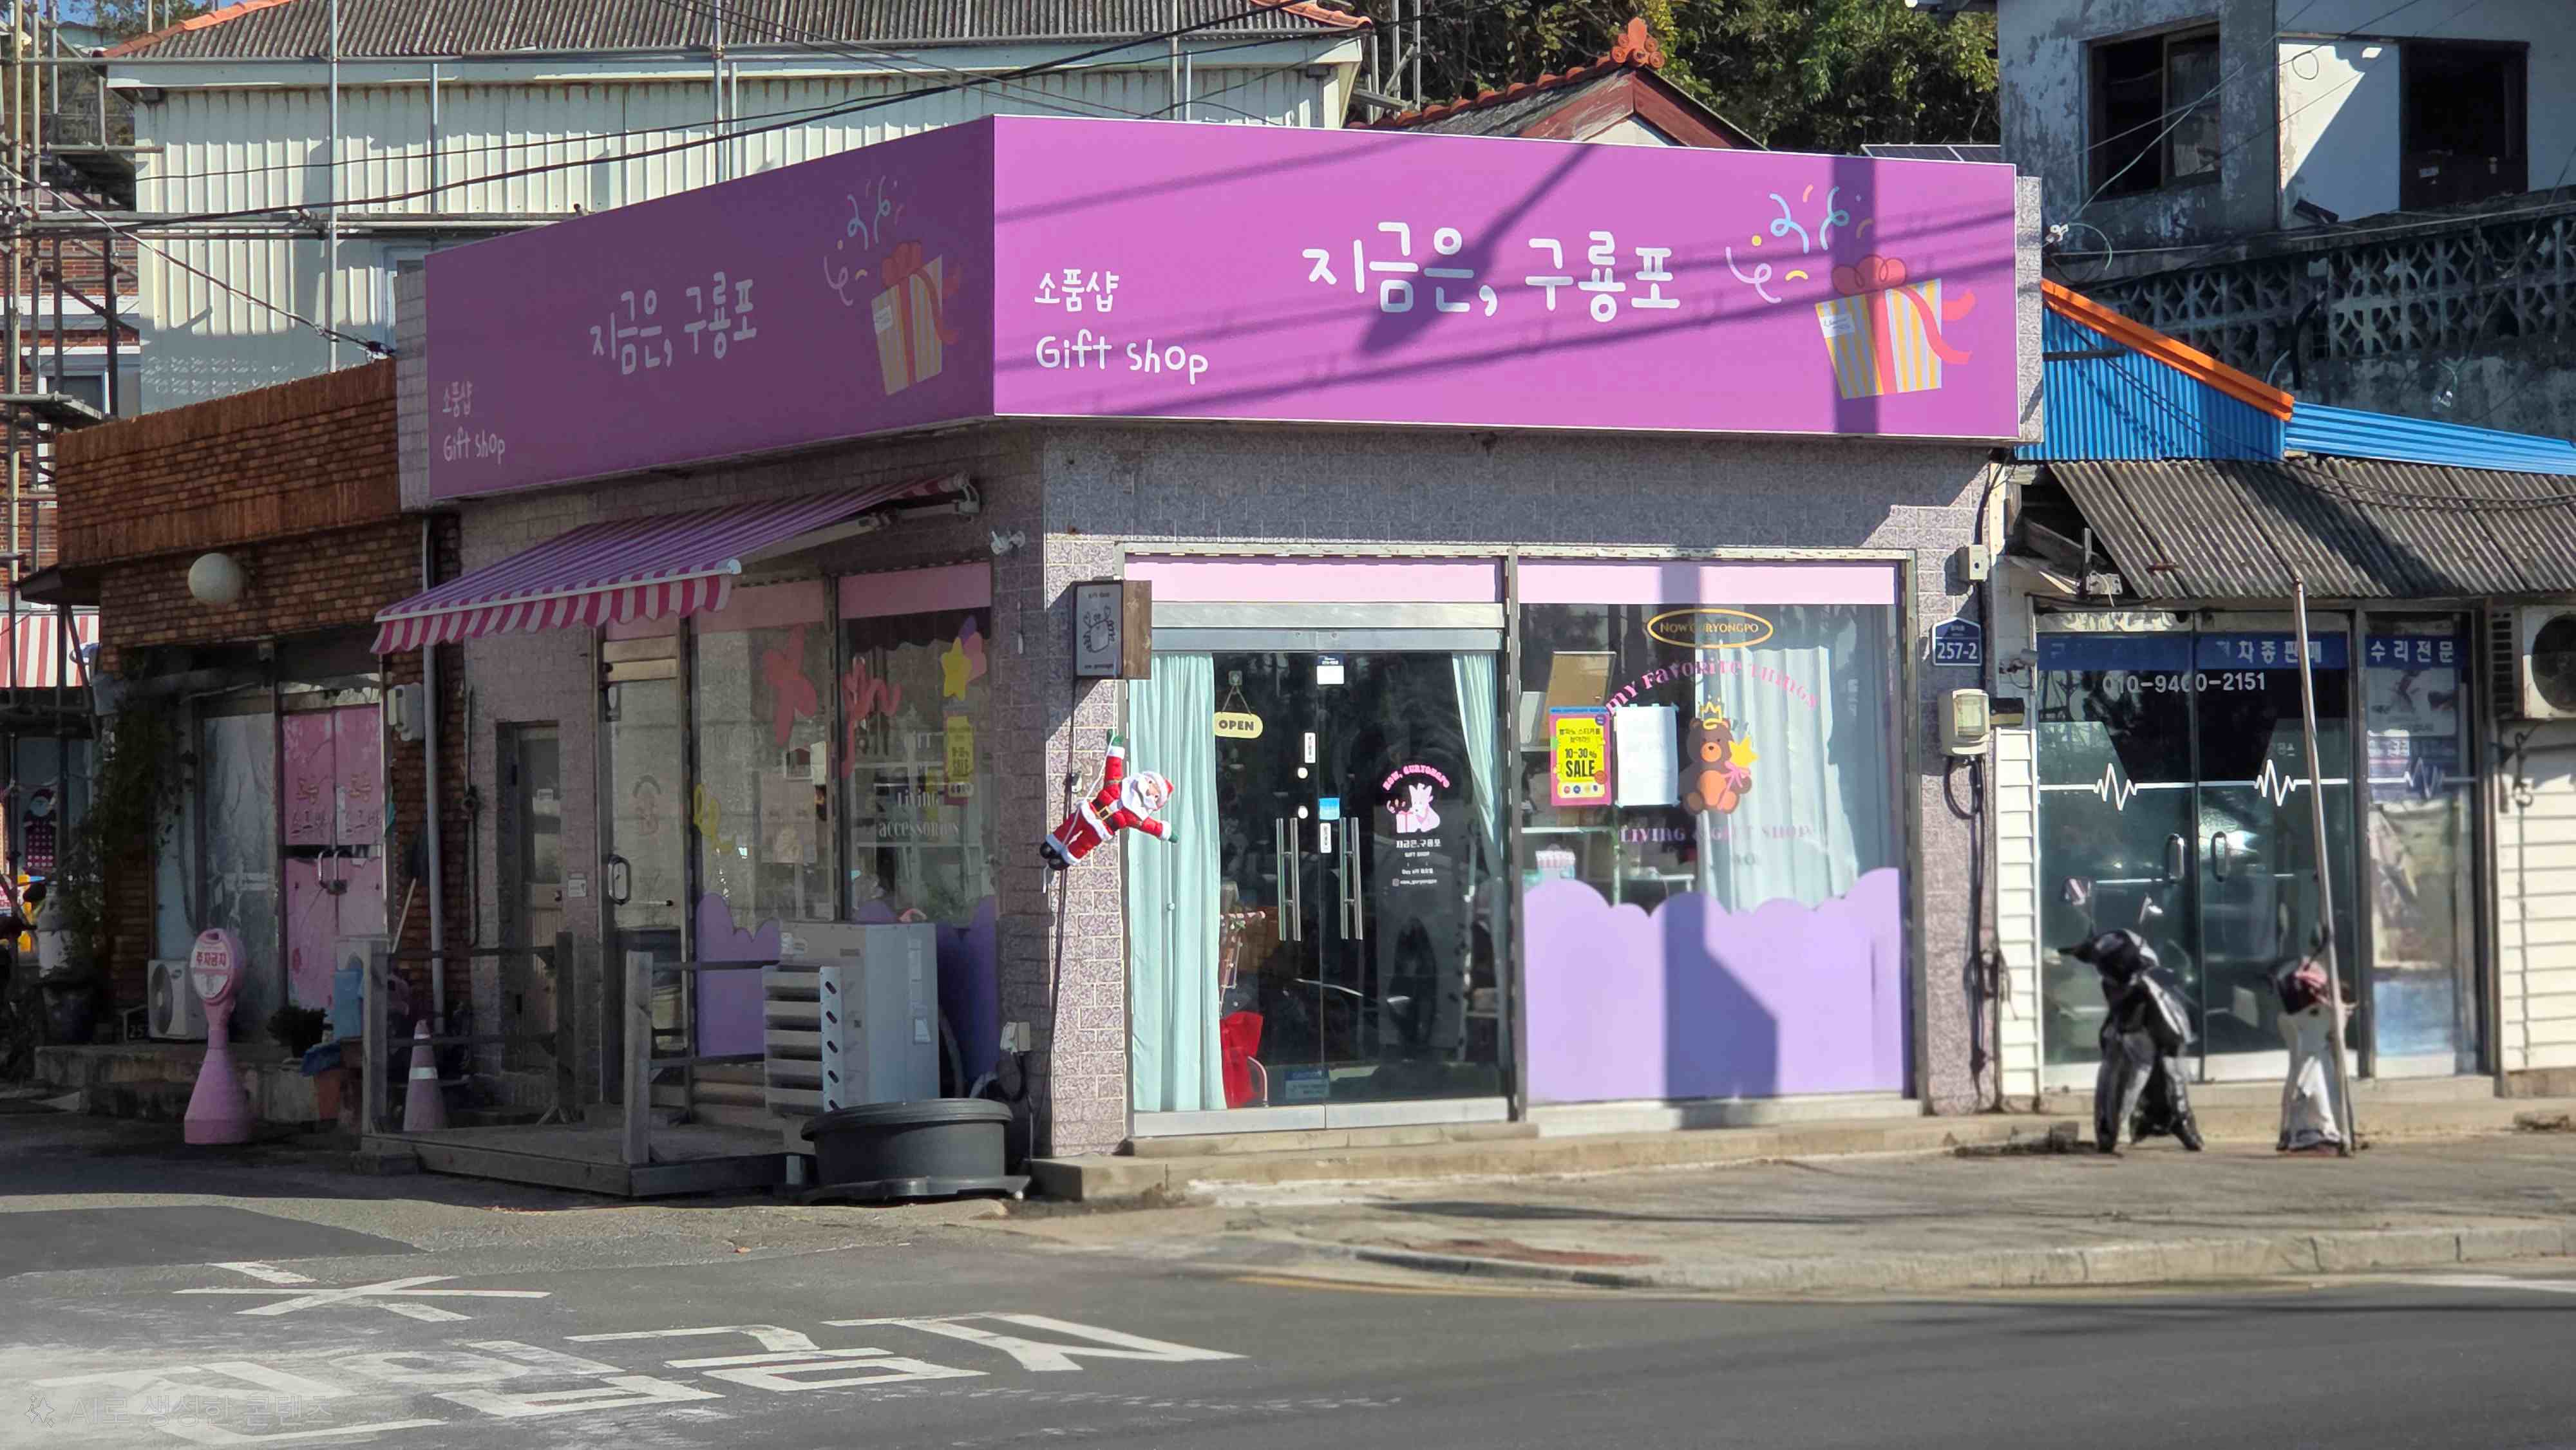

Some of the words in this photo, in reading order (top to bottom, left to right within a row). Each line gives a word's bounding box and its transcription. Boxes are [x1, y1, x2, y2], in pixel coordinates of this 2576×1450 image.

[1302, 221, 1498, 317] 지금은,
[1524, 231, 1680, 323] 구룡포
[1034, 268, 1119, 313] 소품샵
[589, 289, 672, 375] 지금은,
[684, 271, 757, 359] 구룡포
[1036, 328, 1112, 370] Gift
[442, 381, 473, 417] 소품샵
[443, 426, 471, 462] Gift
[1937, 642, 1978, 659] 257-2
[2371, 640, 2454, 663] 수리전문
[1218, 719, 1254, 731] OPEN
[1566, 760, 1596, 777] SALE
